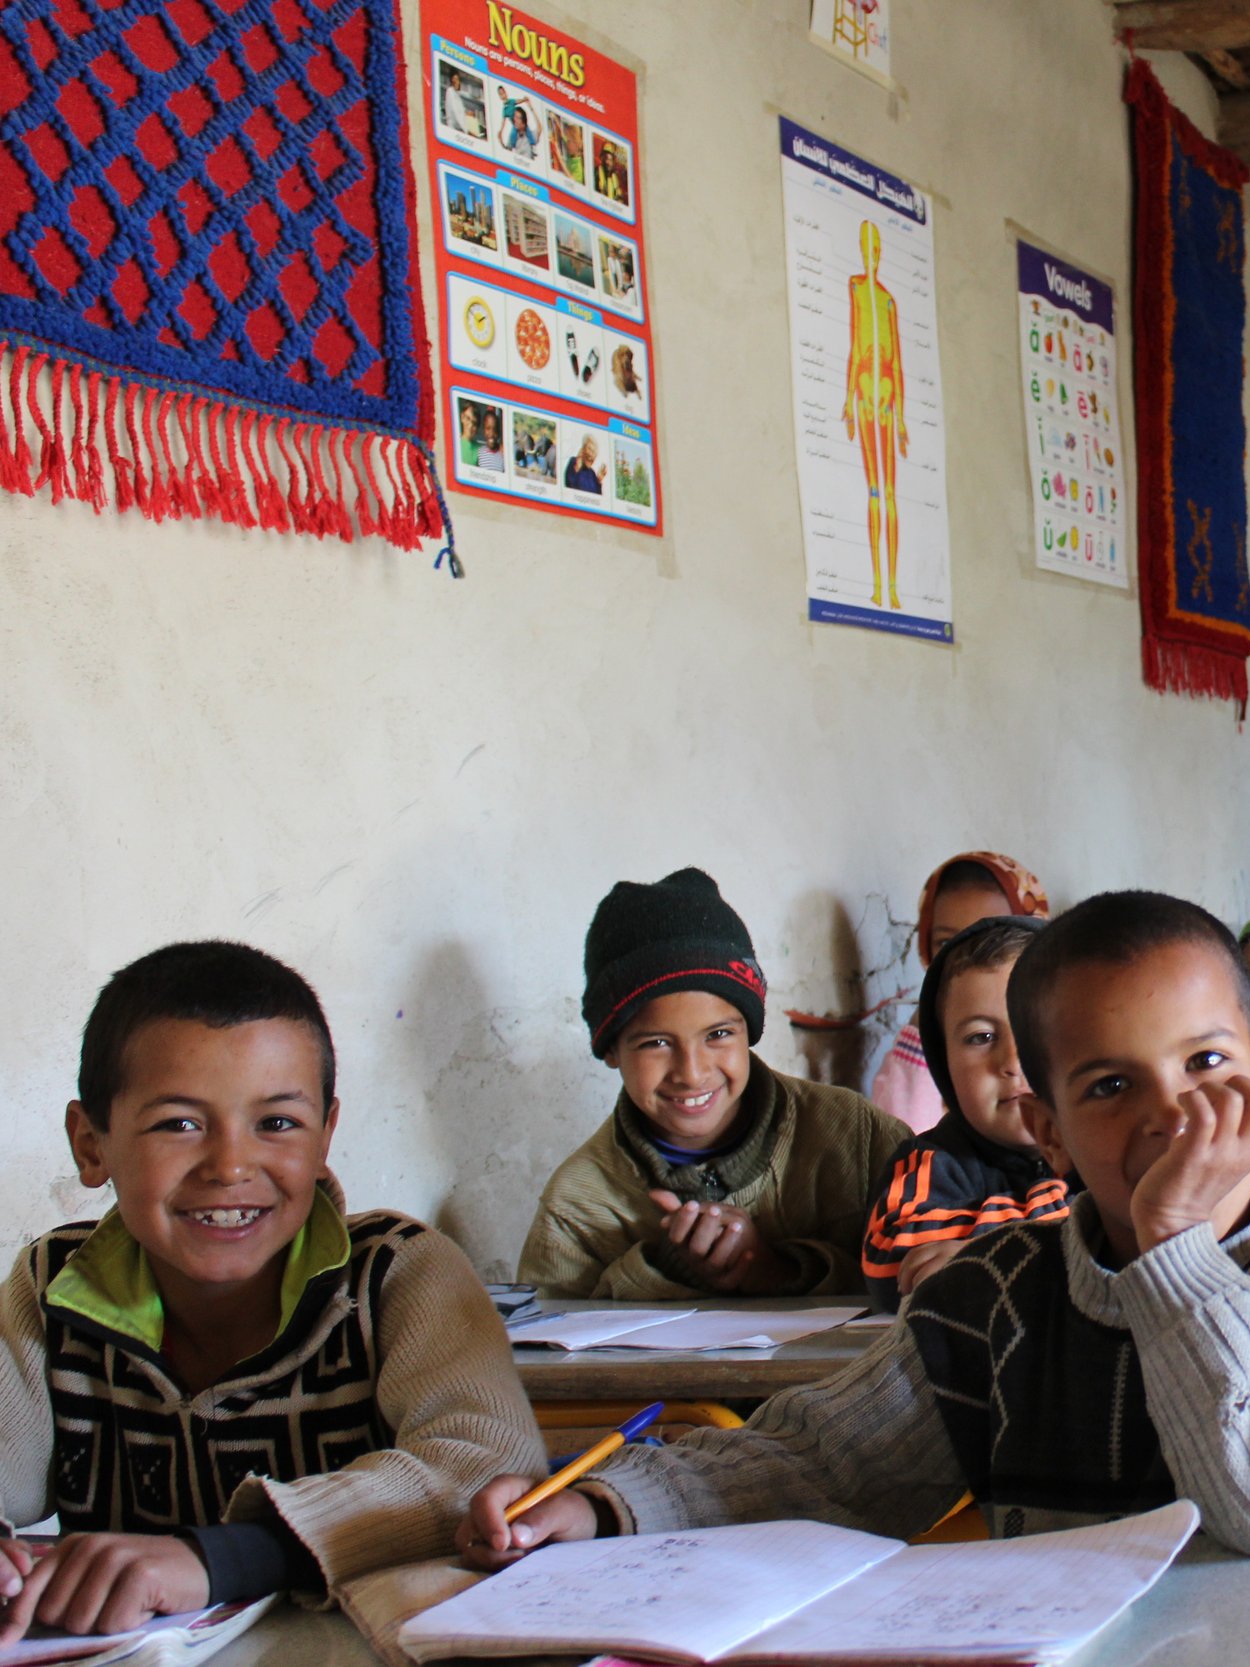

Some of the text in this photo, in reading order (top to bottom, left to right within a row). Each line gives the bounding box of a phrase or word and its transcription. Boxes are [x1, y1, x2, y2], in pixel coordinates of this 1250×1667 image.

[440, 40, 475, 66] Persons
[486, 0, 586, 87] Nouns
[510, 177, 539, 197] Places
[1044, 262, 1093, 311] Vowels
[568, 301, 593, 321] Things
